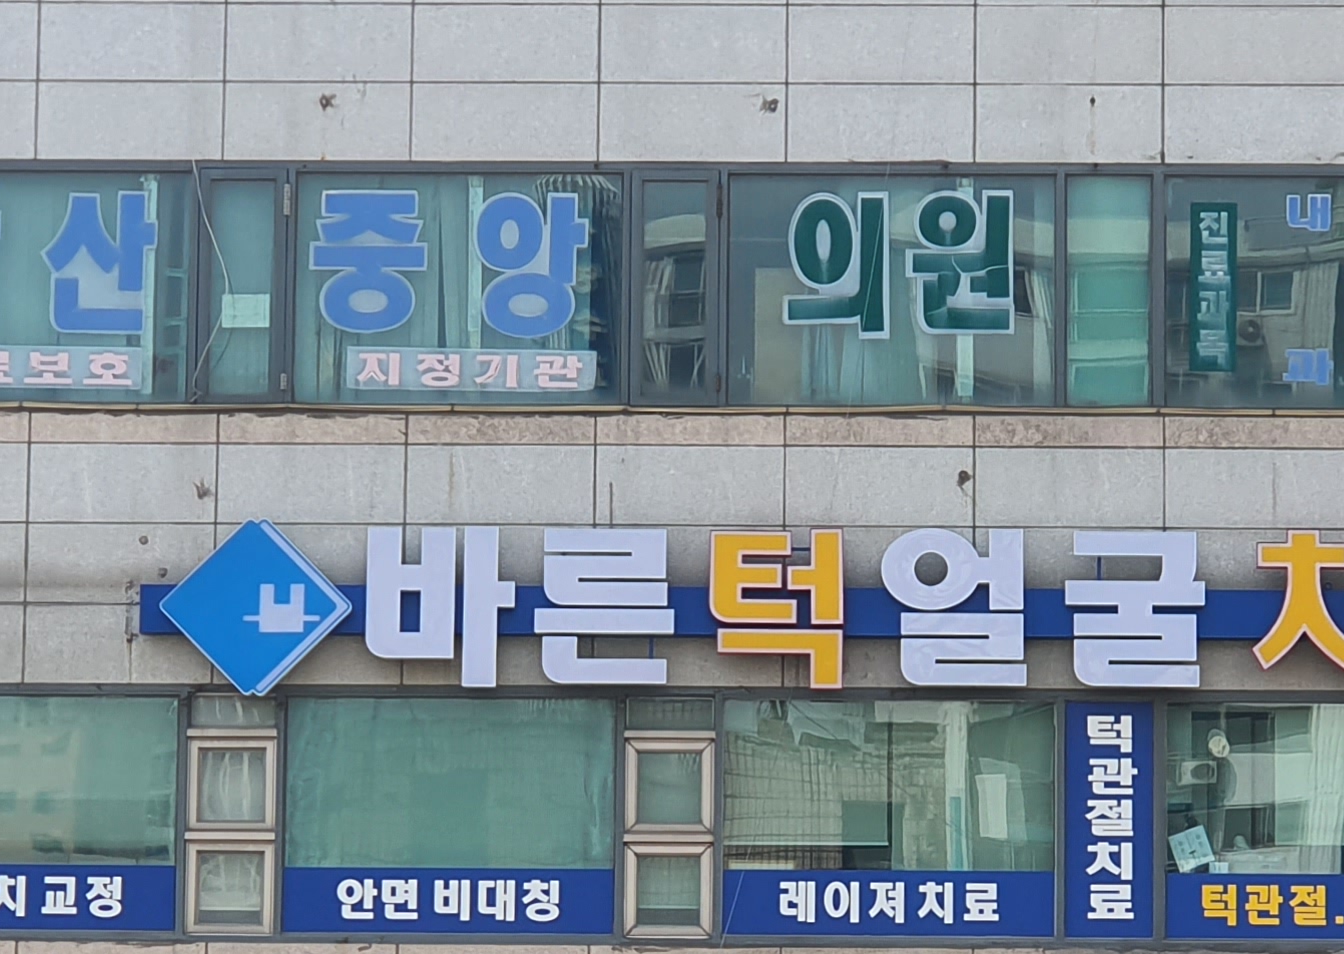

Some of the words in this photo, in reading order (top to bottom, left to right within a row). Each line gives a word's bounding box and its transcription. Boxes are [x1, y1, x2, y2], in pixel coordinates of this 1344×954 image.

[357, 351, 585, 390] 지정기관
[1085, 713, 1138, 921] 턱관절치료
[40, 874, 124, 919] 교정
[335, 877, 420, 922] 안면
[432, 877, 562, 922] 비대칭
